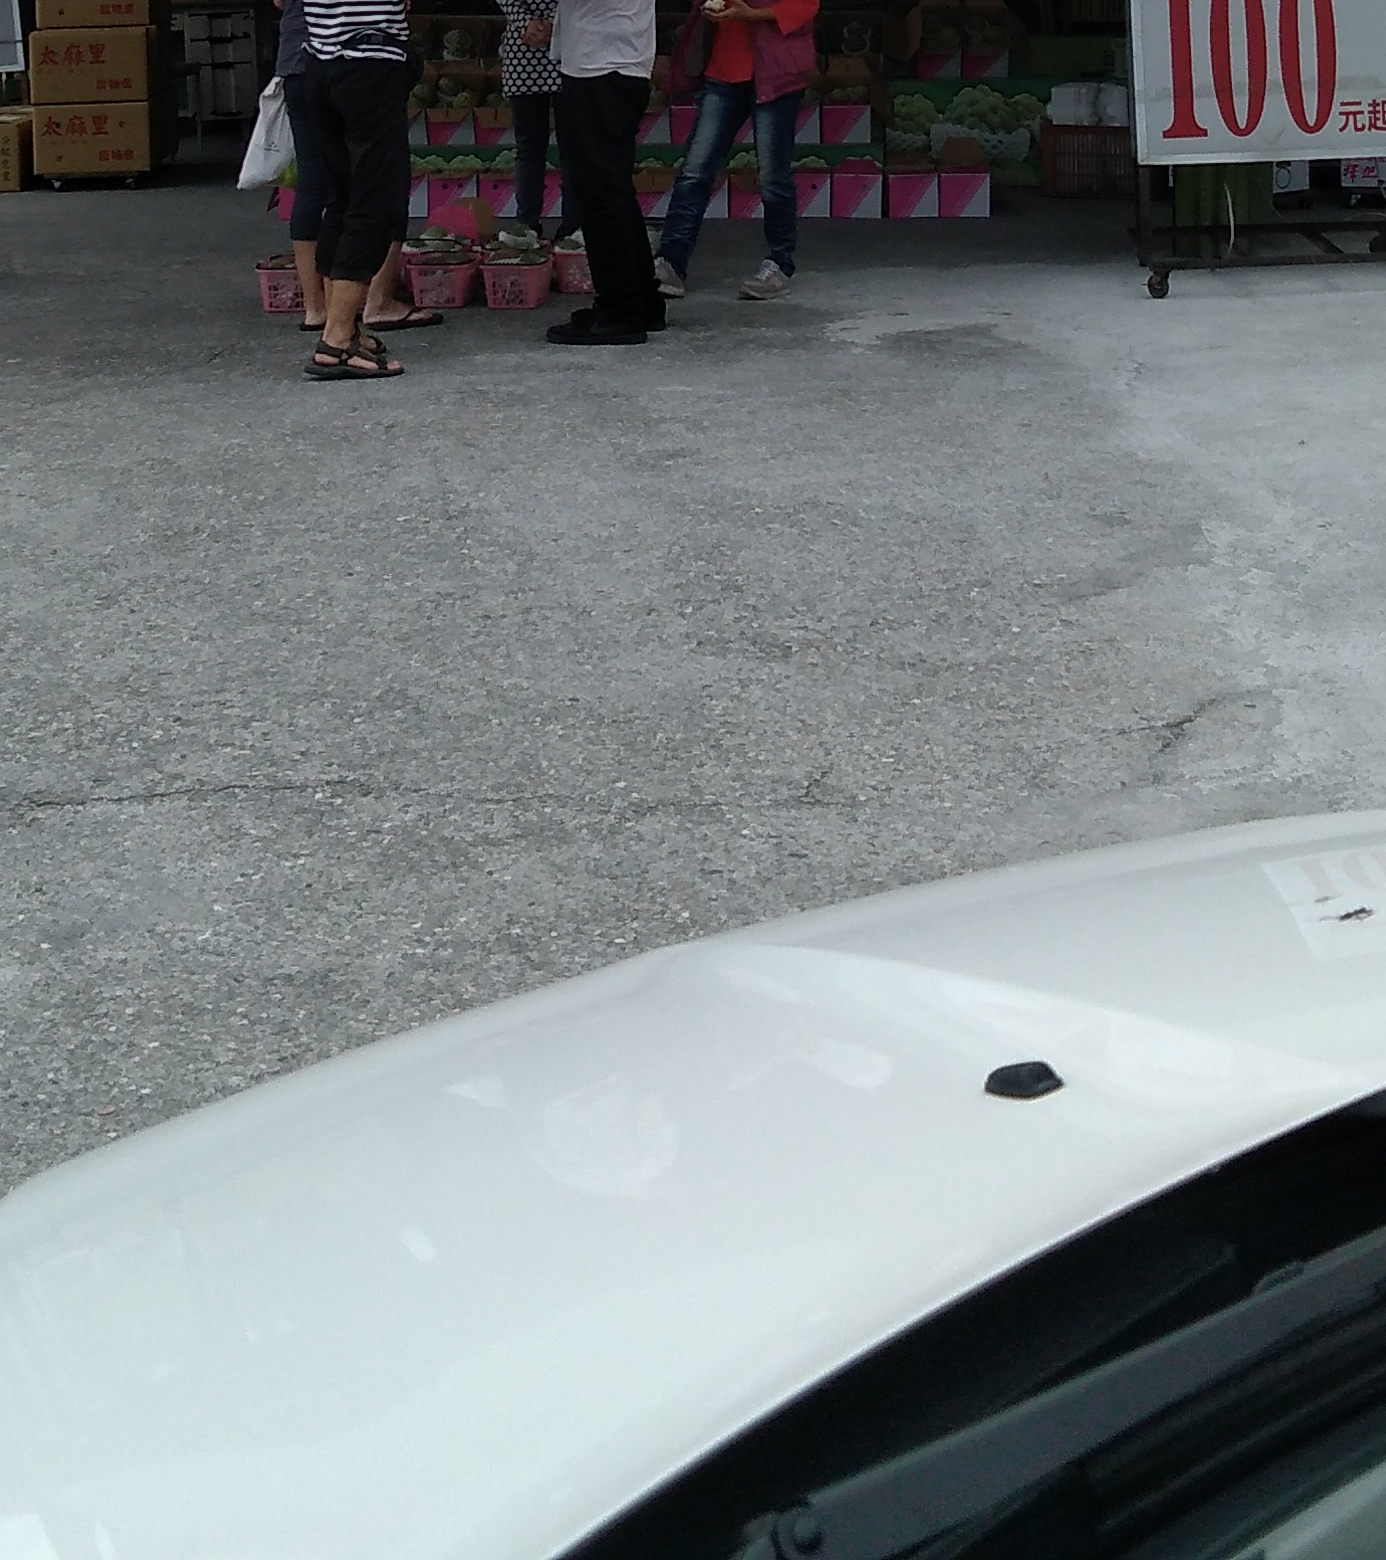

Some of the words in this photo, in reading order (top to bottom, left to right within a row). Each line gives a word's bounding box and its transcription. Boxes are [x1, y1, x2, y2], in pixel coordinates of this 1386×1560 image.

[38, 43, 107, 67] 太麻里
[41, 115, 110, 138] 太麻里
